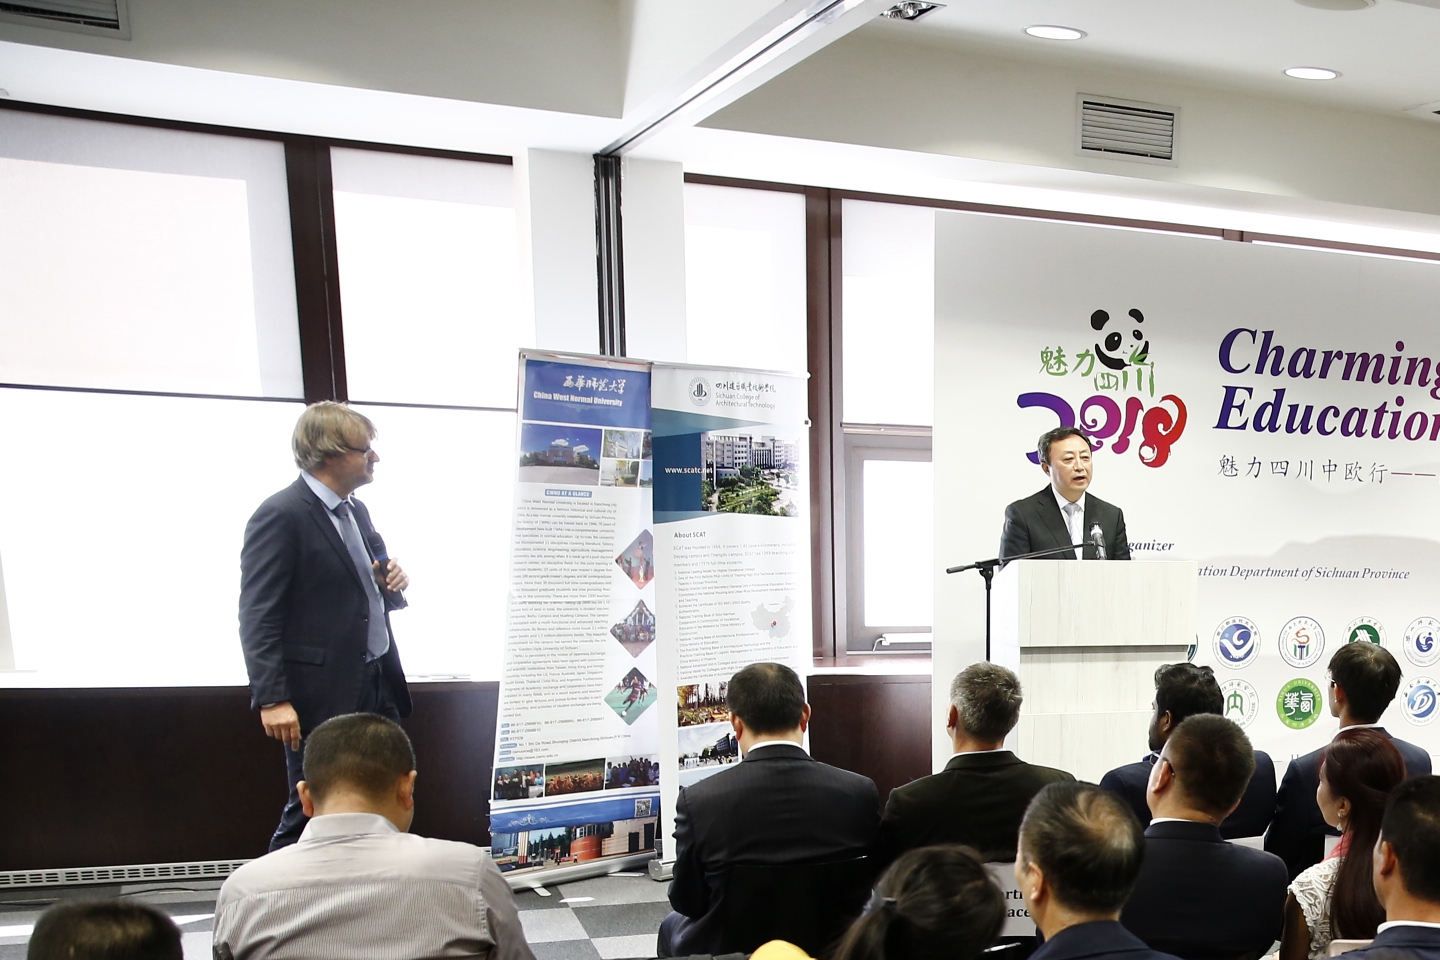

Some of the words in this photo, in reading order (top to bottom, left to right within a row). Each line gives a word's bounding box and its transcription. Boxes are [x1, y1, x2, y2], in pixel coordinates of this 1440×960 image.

[533, 391, 552, 400] China
[553, 393, 570, 401] West
[570, 394, 593, 404] Normal
[593, 397, 623, 407] University
[736, 393, 754, 401] College
[1128, 539, 1174, 552] ganizer
[1198, 565, 1227, 576] ation
[1229, 566, 1300, 580] Department
[1301, 566, 1315, 581] of
[1315, 567, 1360, 579] Sichuan
[1362, 567, 1410, 580] Province
